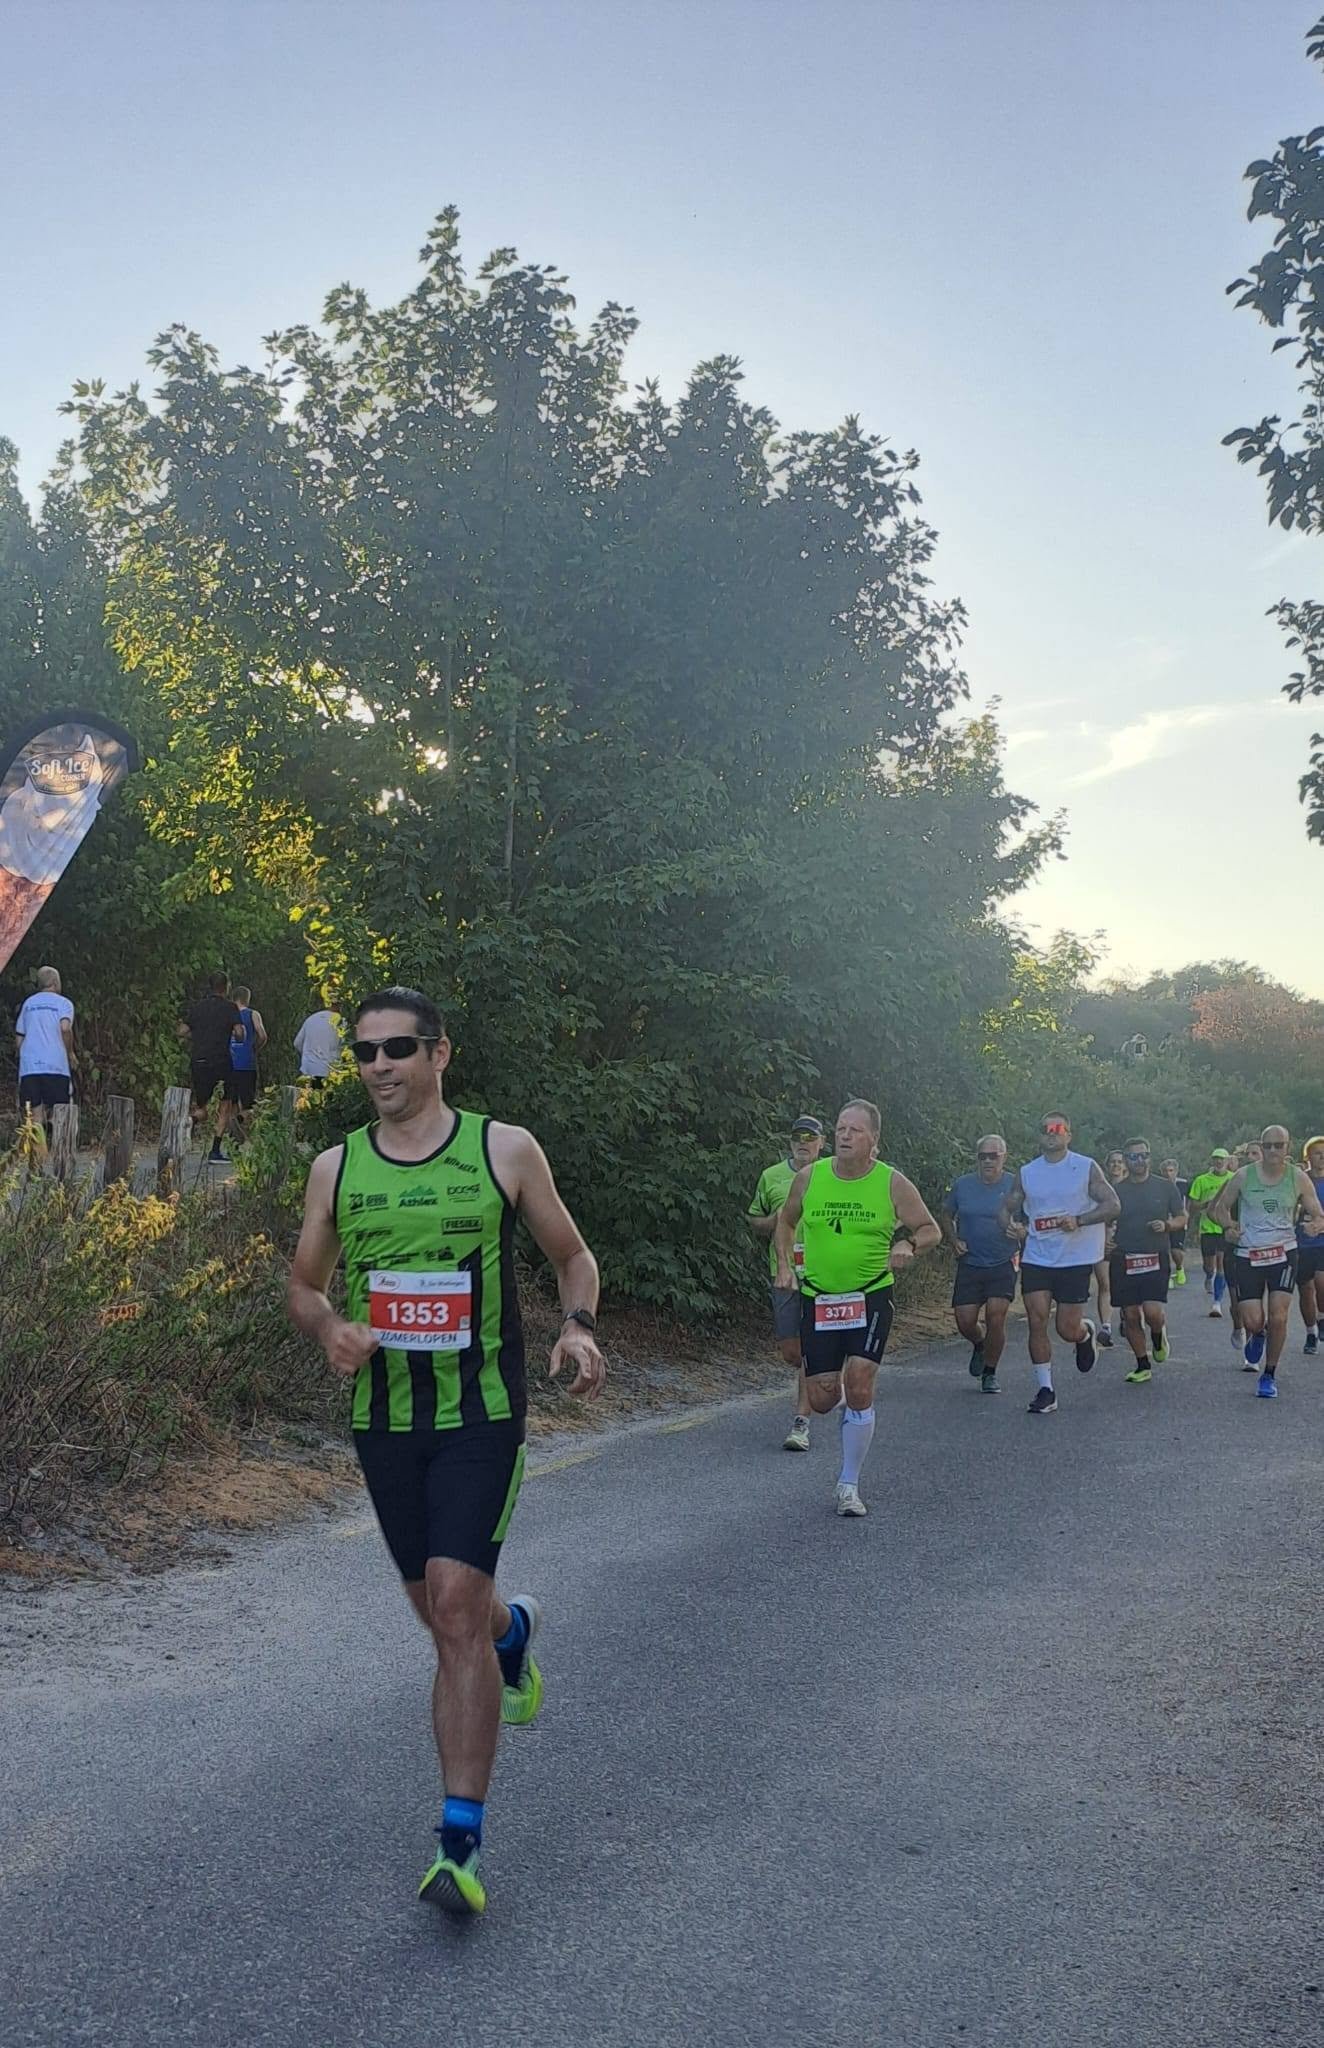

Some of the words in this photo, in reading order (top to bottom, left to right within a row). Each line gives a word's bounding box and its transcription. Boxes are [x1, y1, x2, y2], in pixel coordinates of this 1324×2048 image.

[31, 759, 64, 780] Soft
[65, 757, 90, 773] Ice
[386, 1301, 450, 1325] 1353
[825, 1305, 854, 1318] 3371
[379, 1330, 458, 1345] ZOMERLOPEN
